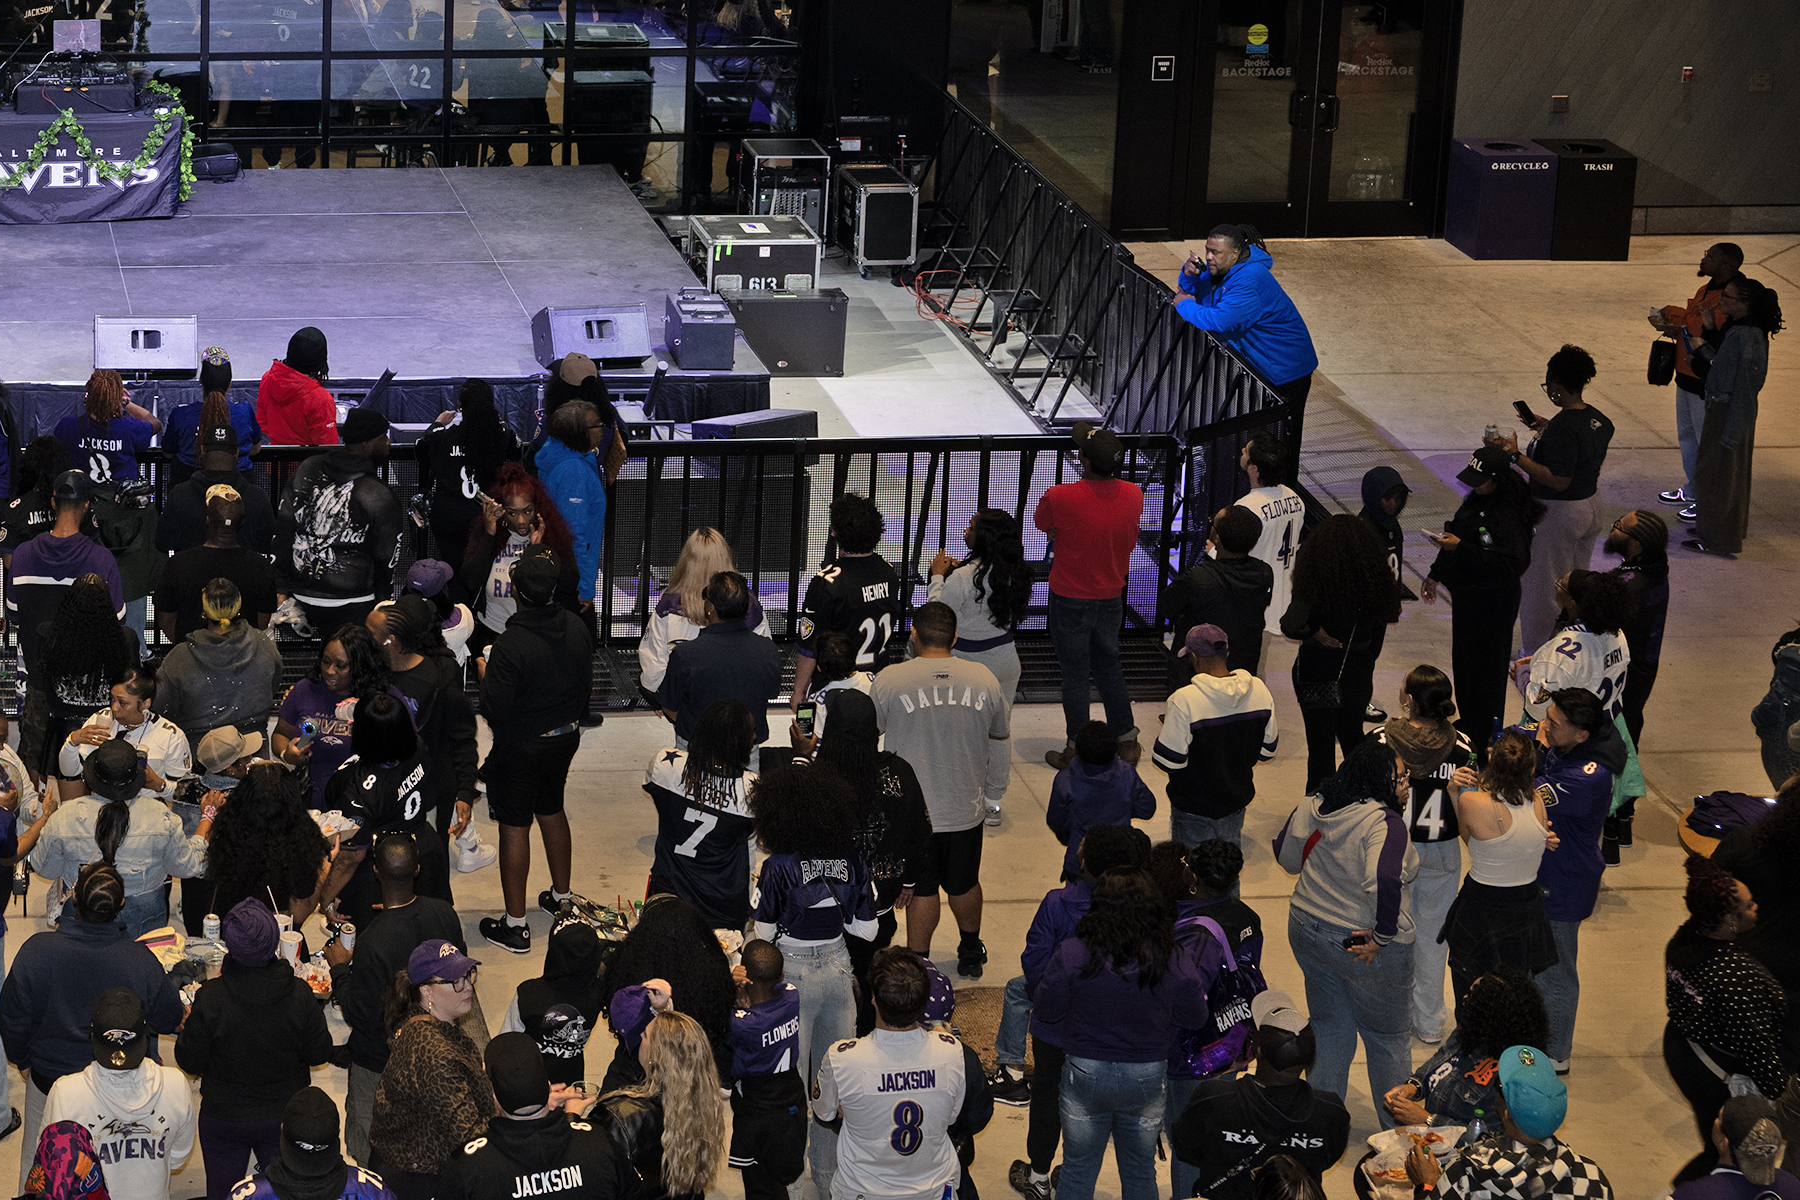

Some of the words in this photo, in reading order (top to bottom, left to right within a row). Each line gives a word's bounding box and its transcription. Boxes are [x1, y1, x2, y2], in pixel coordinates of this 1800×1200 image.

[23, 5, 54, 19] JACKSON
[409, 63, 432, 90] 22
[1222, 67, 1292, 77] BACKSTAGE
[1344, 66, 1414, 76] BACKSTAGE
[1499, 162, 1541, 170] RECYCLE
[1583, 163, 1614, 171] TRASH
[749, 277, 778, 291] 613
[89, 453, 111, 485] 8
[1261, 496, 1301, 521] FLOWERS
[1275, 518, 1298, 572] 4
[859, 582, 888, 603] HENRY
[1556, 636, 1583, 661] 22
[900, 686, 987, 715] DALLAS
[1582, 761, 1595, 775] 8
[361, 773, 377, 792] 8
[397, 761, 426, 802] JACKSON
[679, 806, 719, 859] 7
[800, 859, 849, 885] RAVENS
[1215, 1002, 1252, 1032] RAVENS
[761, 1015, 800, 1048] FLOWERS
[837, 1039, 858, 1054] 8
[877, 1069, 936, 1093] JACKSON
[889, 1099, 924, 1156] 8
[1221, 1129, 1324, 1150] RANS
[97, 1137, 165, 1165] AVENS
[463, 1137, 488, 1155] 8
[511, 1164, 583, 1200] JACKSON
